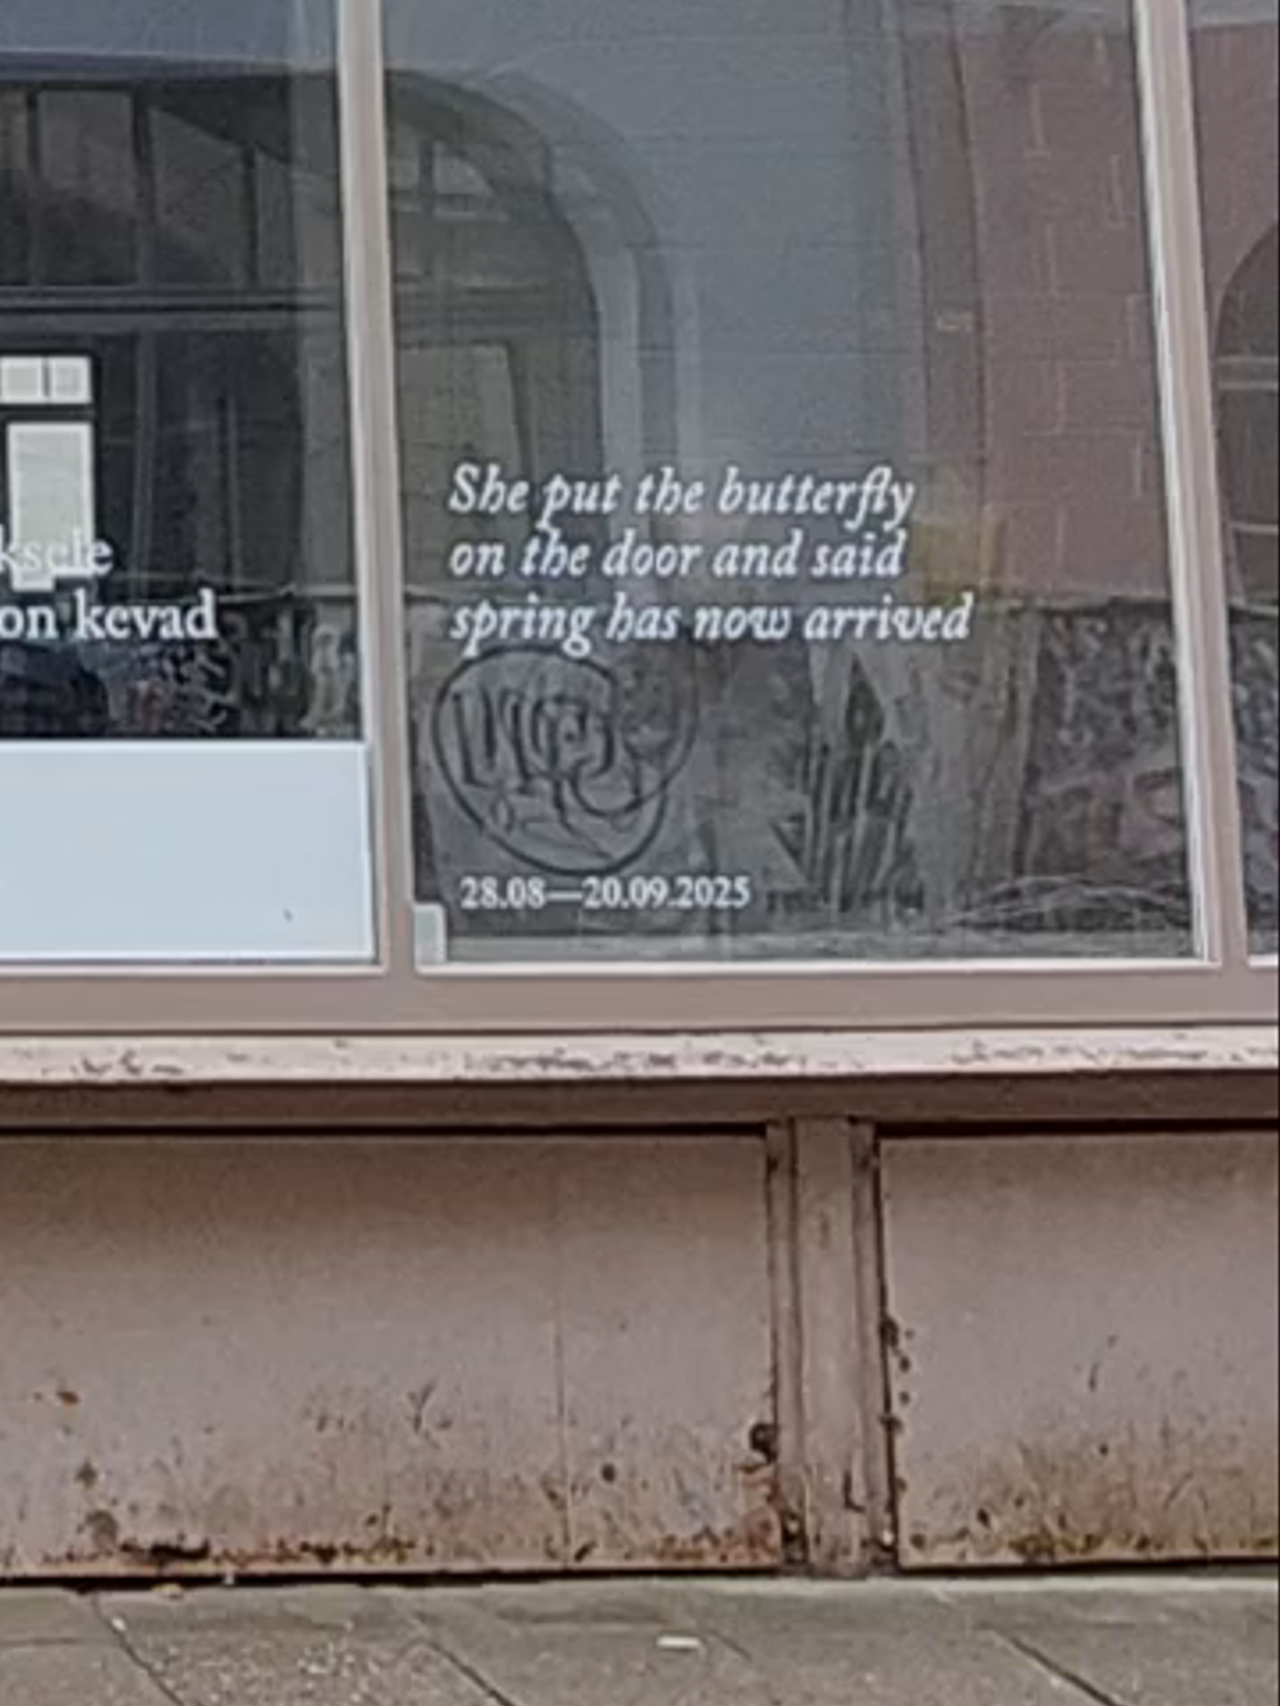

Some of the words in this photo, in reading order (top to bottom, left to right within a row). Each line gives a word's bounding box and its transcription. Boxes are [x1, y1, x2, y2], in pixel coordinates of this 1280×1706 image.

[449, 463, 529, 515] She
[535, 472, 623, 530] put
[636, 468, 703, 514] the
[718, 467, 915, 532] butterfly
[449, 547, 504, 577] on
[521, 530, 588, 577] the
[602, 528, 702, 578] door
[712, 528, 802, 579] and
[811, 529, 908, 578] said
[75, 590, 217, 643] kevad
[448, 599, 591, 657] spring
[607, 595, 678, 640] has
[694, 606, 792, 641] now
[803, 593, 974, 642] arrived
